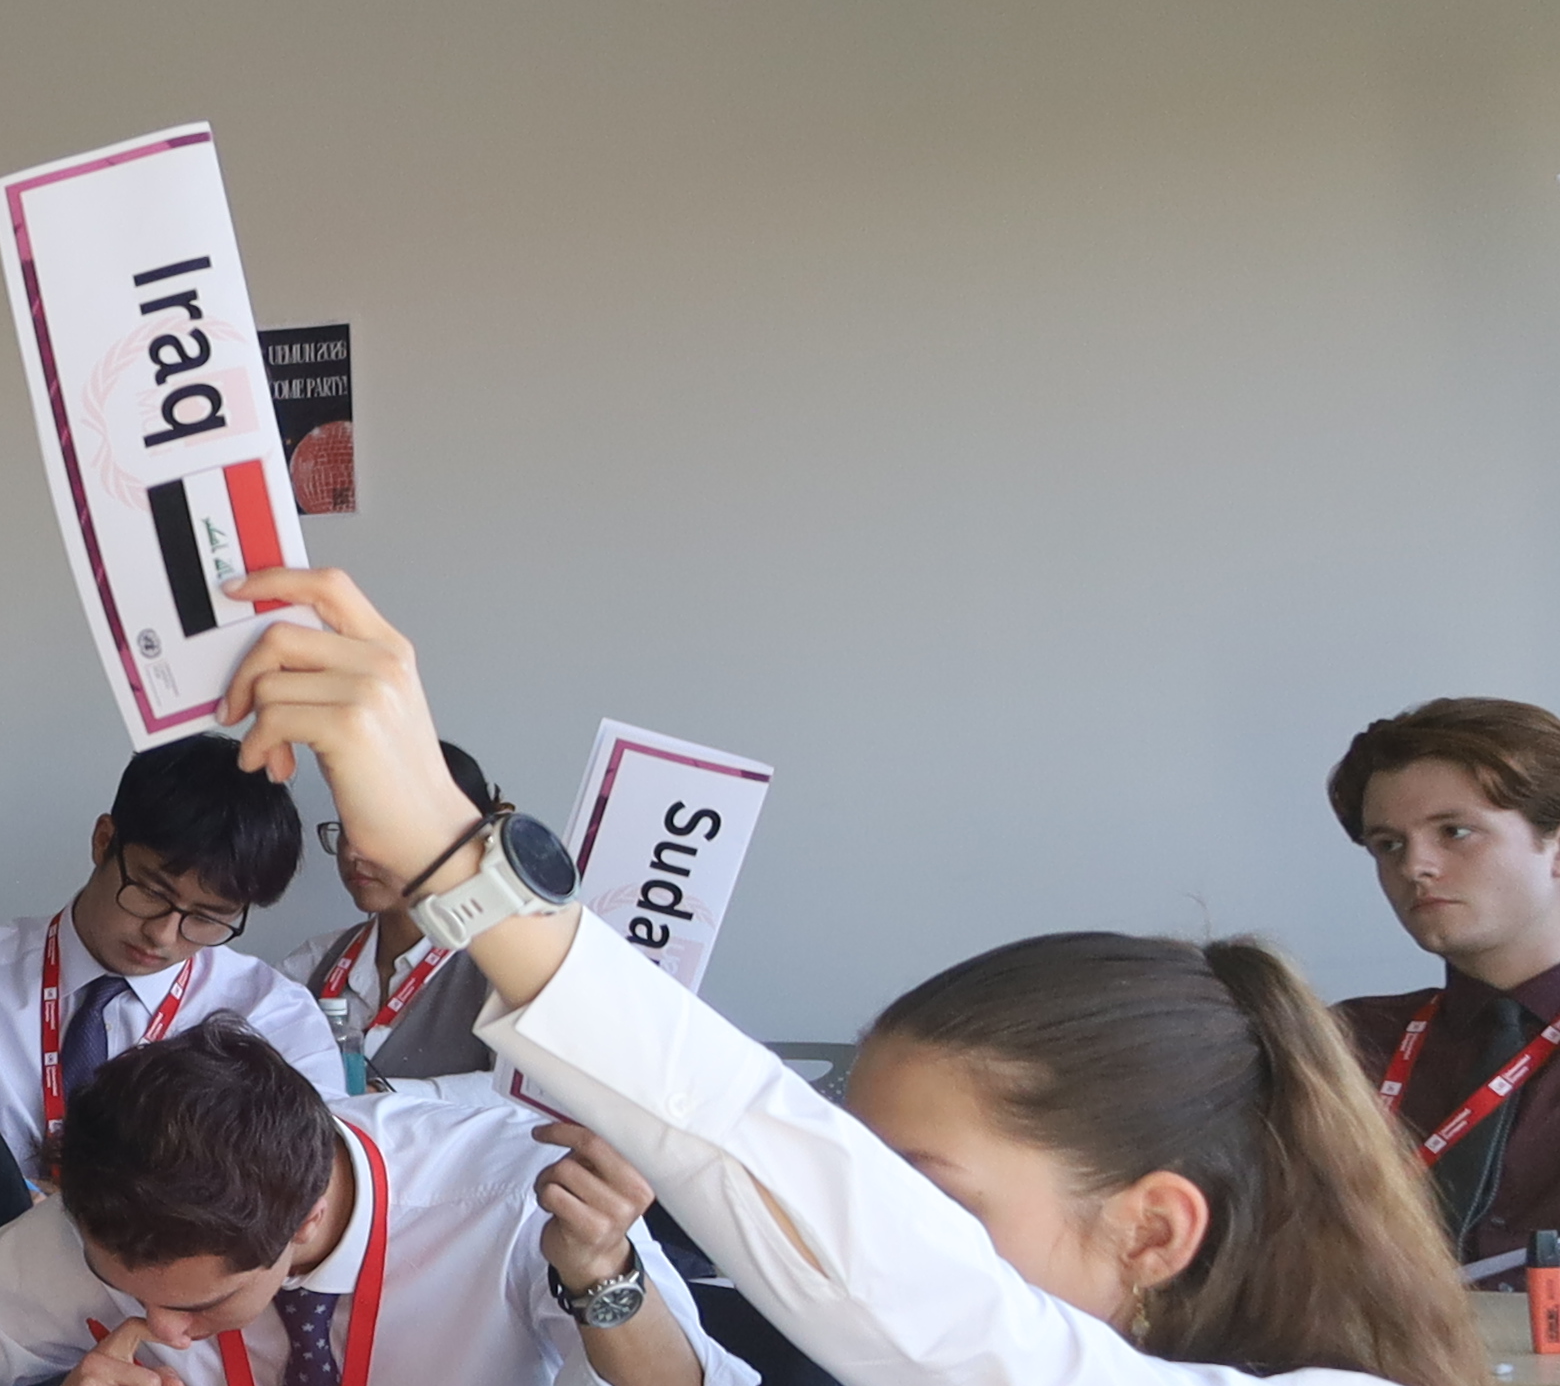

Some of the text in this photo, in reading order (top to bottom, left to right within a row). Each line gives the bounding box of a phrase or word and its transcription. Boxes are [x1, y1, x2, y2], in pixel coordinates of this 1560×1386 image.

[133, 255, 227, 450] Iraq
[306, 375, 348, 399] PARTY!
[627, 799, 722, 968] Suda
